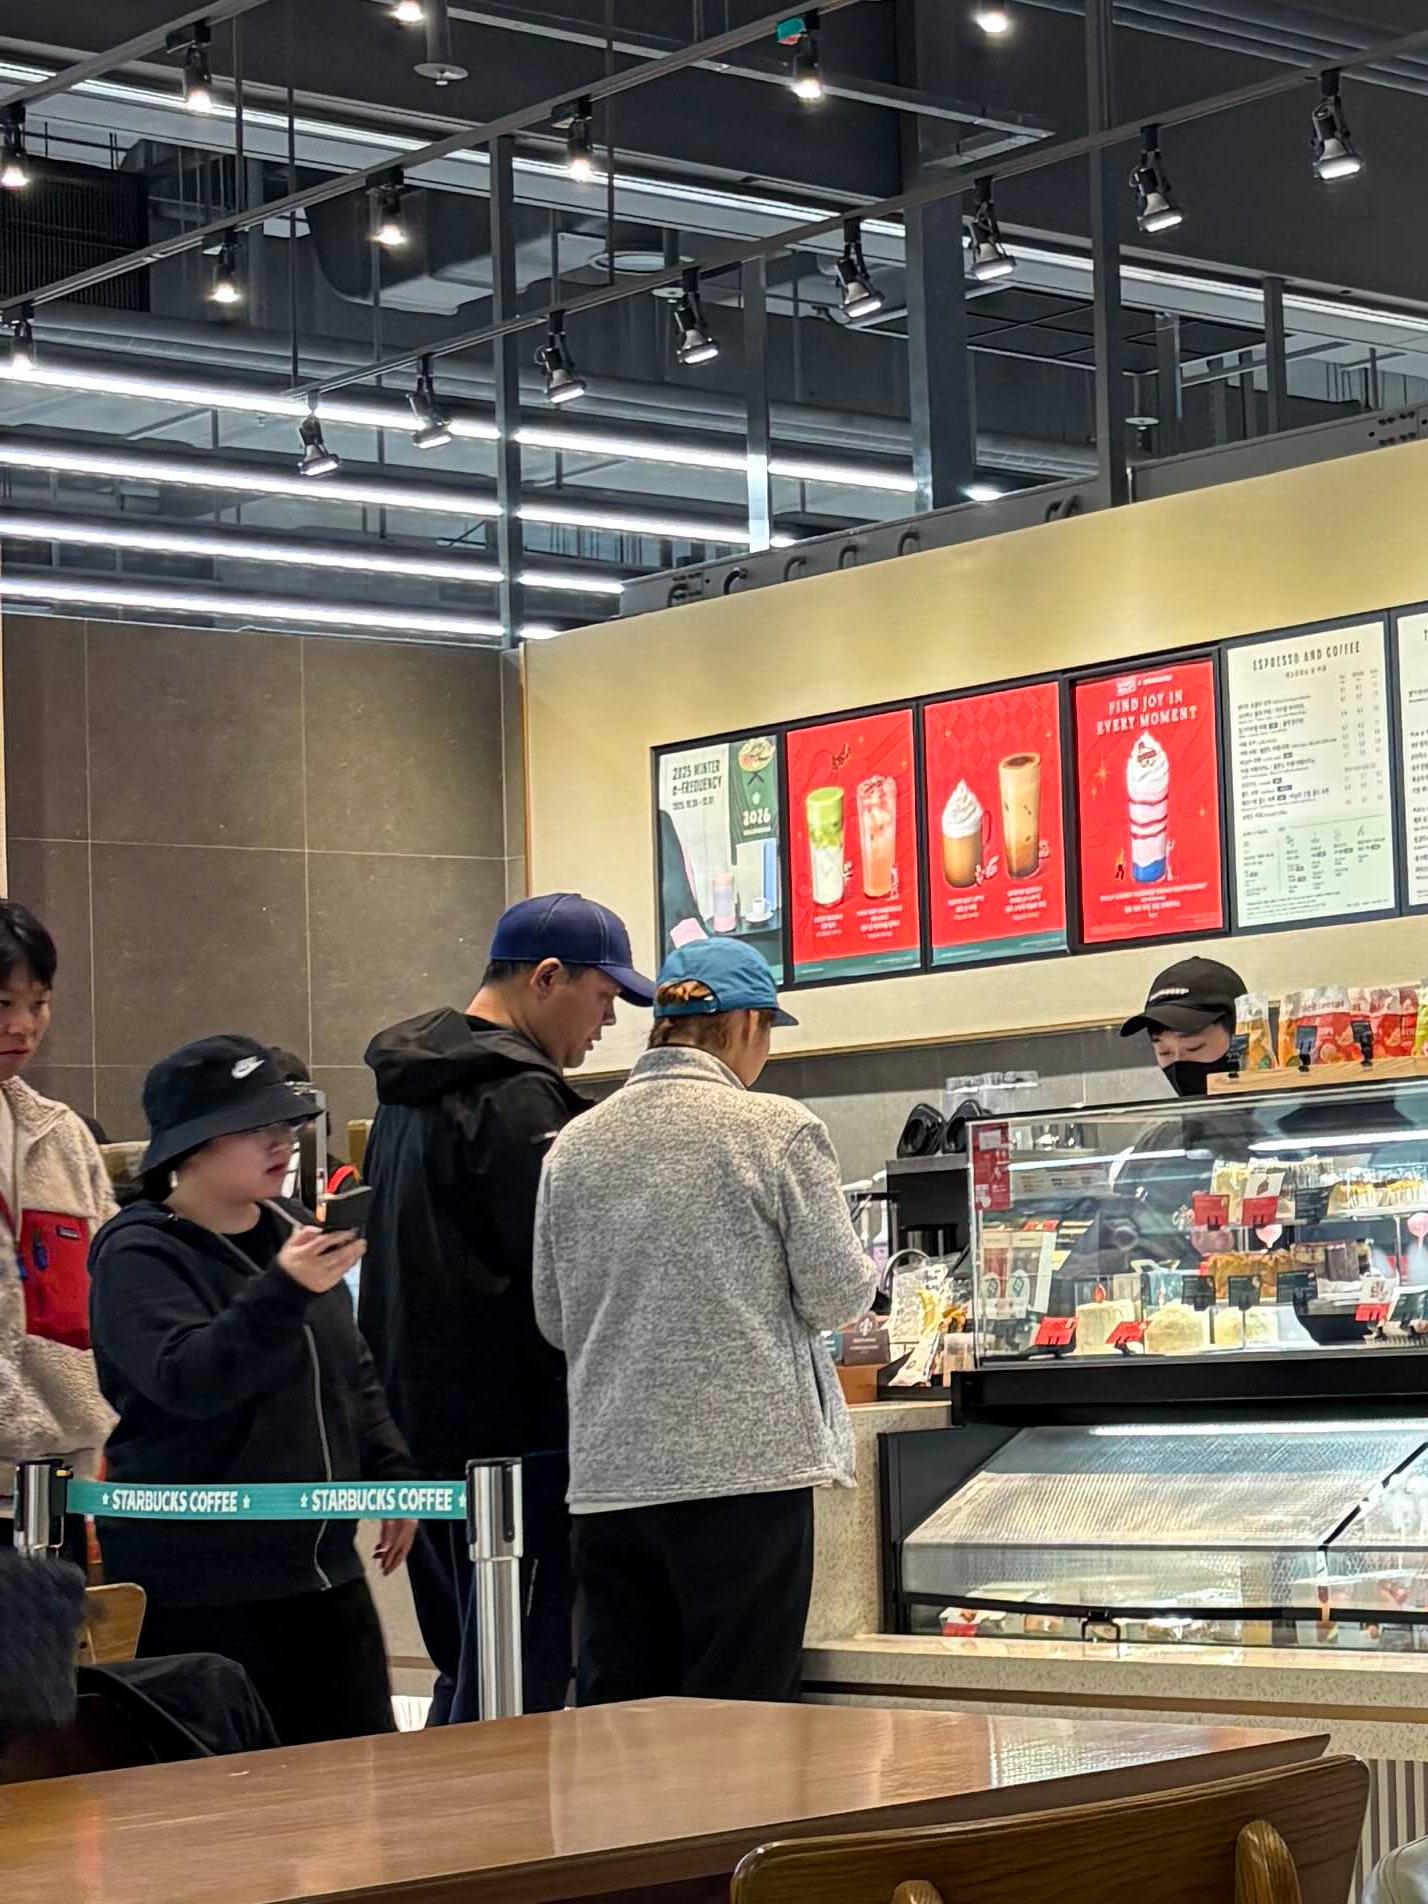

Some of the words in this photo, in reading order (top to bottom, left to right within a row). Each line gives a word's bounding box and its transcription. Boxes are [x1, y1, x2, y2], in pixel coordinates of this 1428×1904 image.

[1253, 653, 1299, 671] ESPRESSO
[1304, 649, 1322, 662] AND
[1326, 641, 1360, 658] COFFEE
[1108, 698, 1138, 715] FIND
[1143, 693, 1164, 712] JOY
[1168, 688, 1183, 704] IN
[1096, 716, 1135, 736] EVERY
[1140, 705, 1197, 727] MOMENT
[742, 807, 772, 826] 2026
[112, 1489, 187, 1512] STARBUCKS
[189, 1491, 238, 1512] COFFEE
[311, 1489, 395, 1511] STARBUCKS
[398, 1489, 453, 1511] COFFEE
